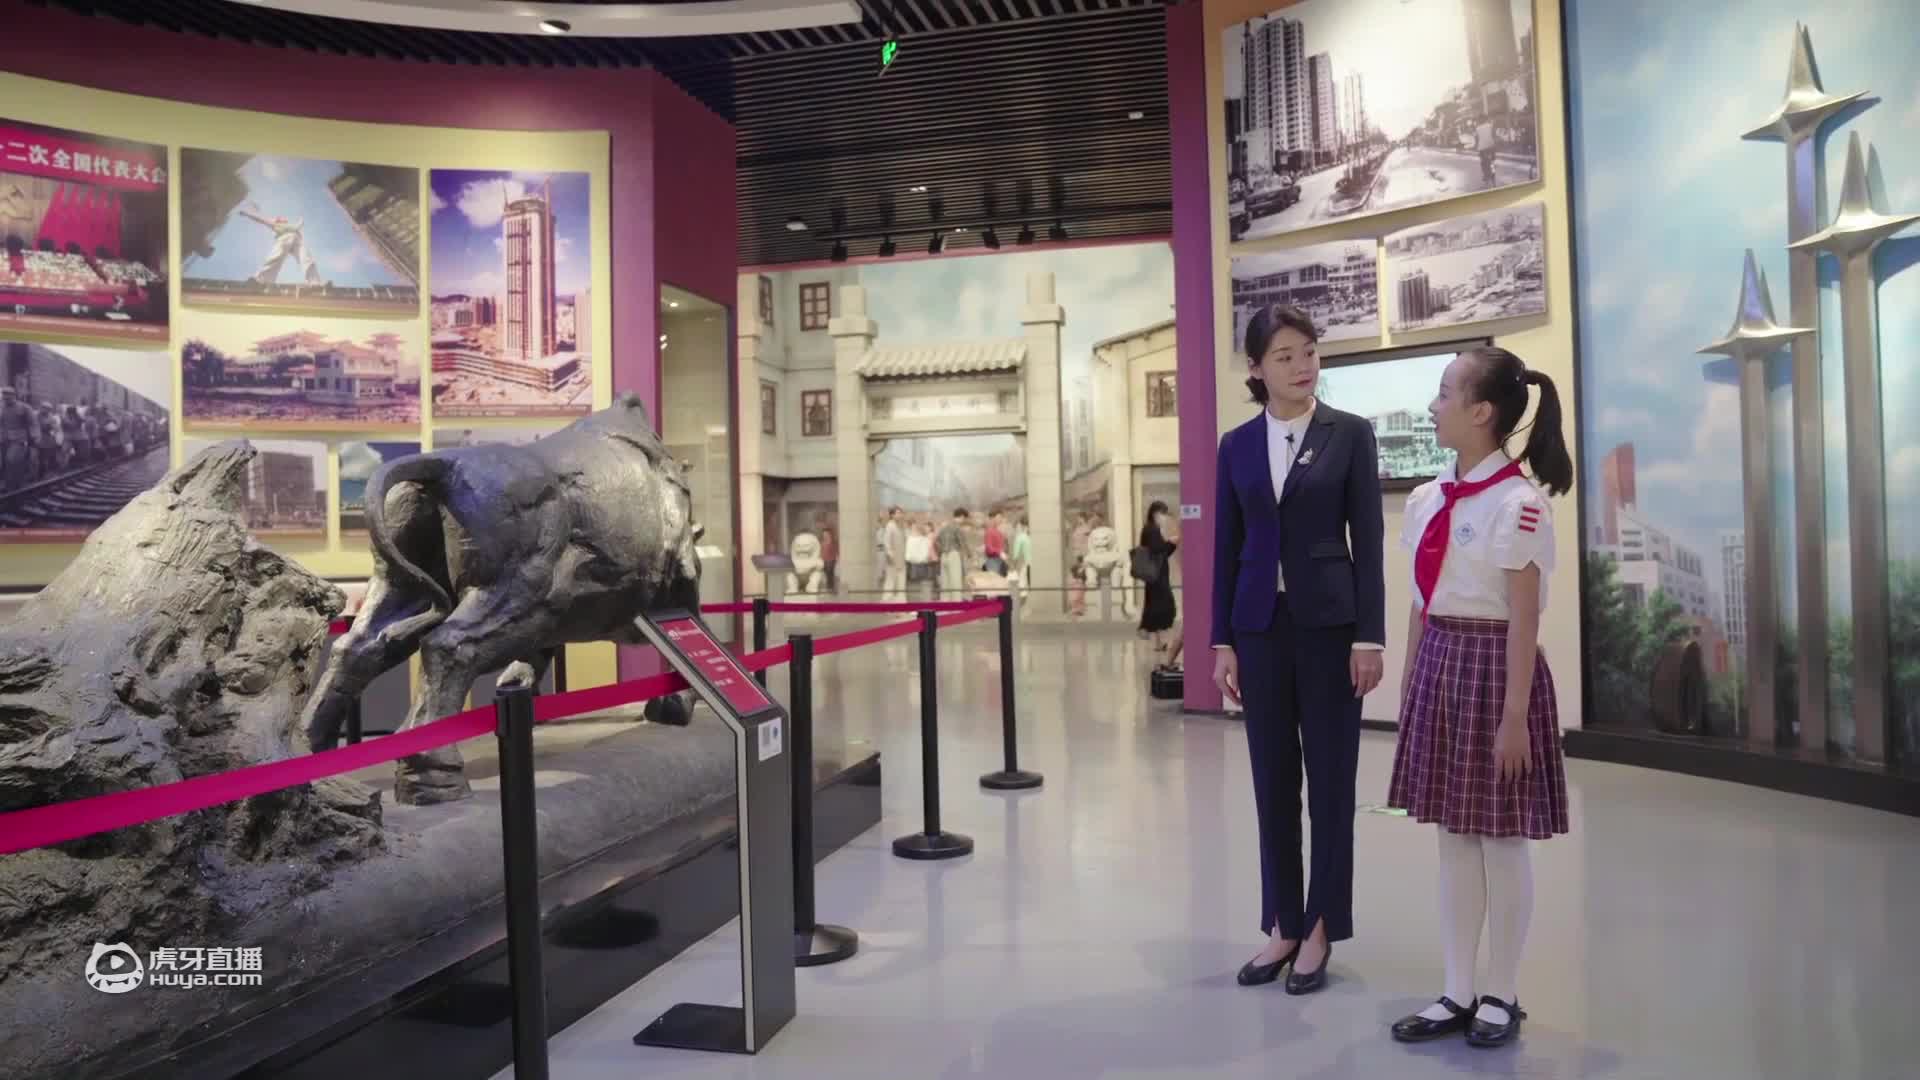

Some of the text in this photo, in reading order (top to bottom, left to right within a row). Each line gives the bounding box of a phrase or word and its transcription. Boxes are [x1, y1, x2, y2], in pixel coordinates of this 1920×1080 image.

[0, 141, 167, 184] 二次全国代表大会
